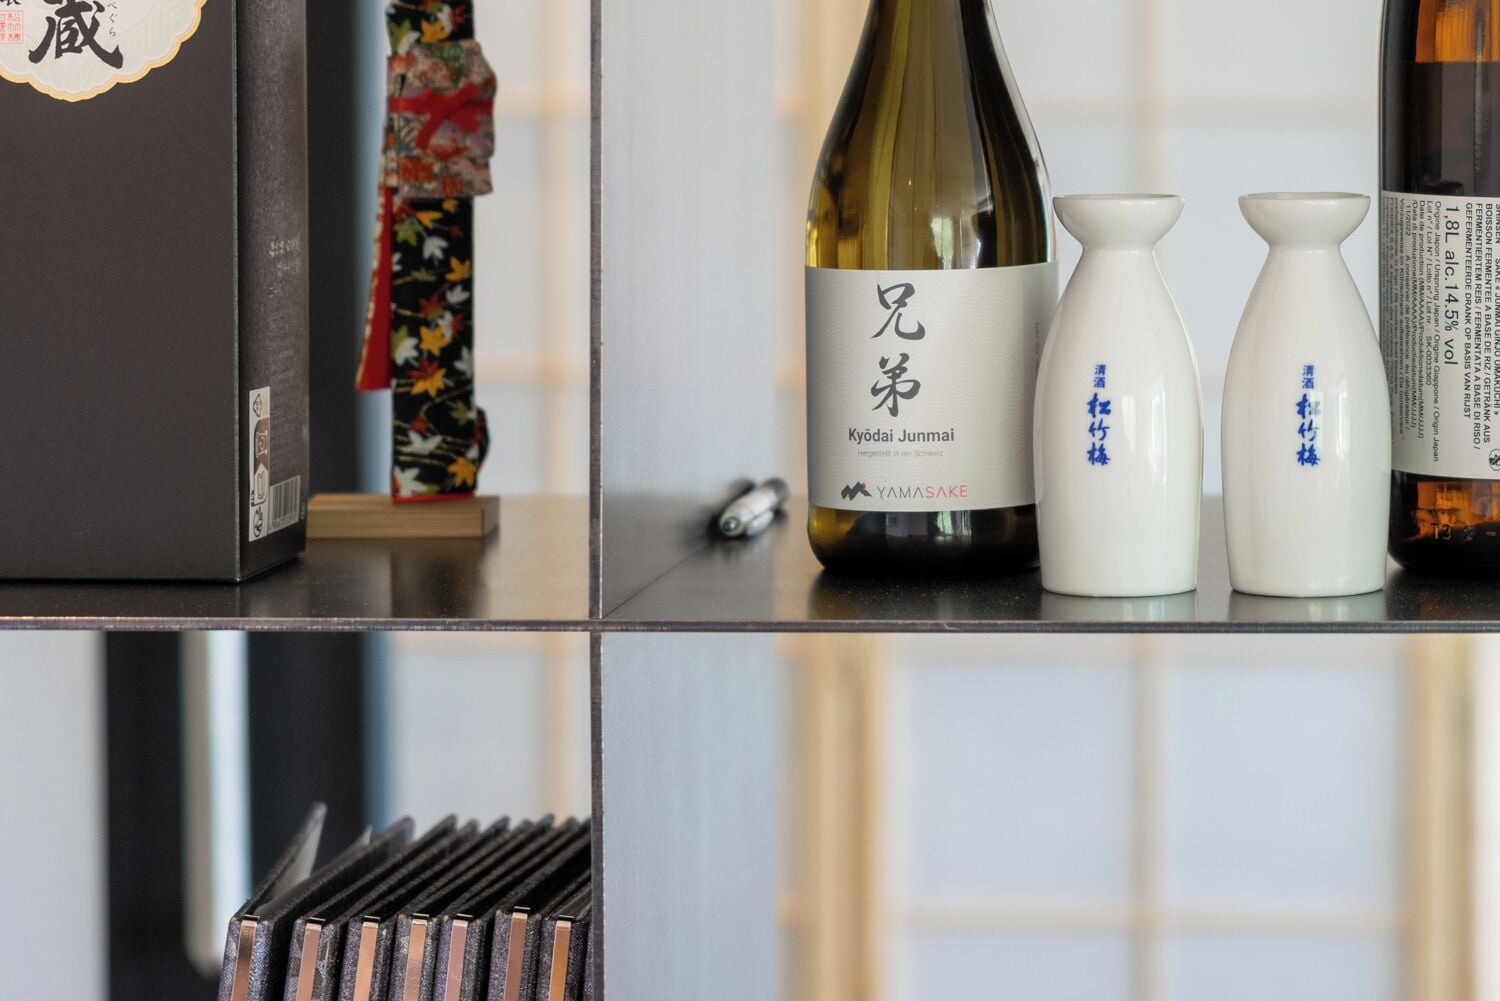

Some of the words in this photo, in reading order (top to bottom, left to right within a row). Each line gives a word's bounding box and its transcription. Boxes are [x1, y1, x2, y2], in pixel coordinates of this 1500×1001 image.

[1419, 221, 1425, 232] de
[1433, 200, 1441, 230] Origine
[1444, 205, 1460, 243] 1,8L
[1485, 203, 1493, 245] BOISSON
[1433, 232, 1441, 256] Japon
[1465, 202, 1473, 291] GEFERMENTEERDE
[1474, 203, 1483, 281] FERMENTIERTEM
[1433, 264, 1441, 301] Ursprung
[1484, 247, 1492, 303] FERMENTEE
[1474, 282, 1482, 305] REIS
[1433, 302, 1441, 328] Japan
[1464, 292, 1472, 325] DRANK
[1484, 304, 1492, 312] A
[1464, 327, 1472, 340] OP
[1484, 314, 1492, 339] BASE
[870, 282, 926, 418] 兄弟
[1433, 334, 1441, 364] Origine
[1444, 338, 1459, 365] vol
[1474, 311, 1482, 373] FERMENTATA
[1484, 340, 1492, 354] DE
[1464, 341, 1472, 370] BASIS
[1484, 355, 1492, 371] RIZ
[1433, 365, 1441, 405] Giappone
[1464, 371, 1472, 391] VAN
[1474, 374, 1481, 382] A
[1493, 359, 1500, 409] UMAKUCHI
[1464, 392, 1472, 419] RIJST
[1473, 383, 1481, 409] BASE
[1483, 377, 1492, 422] GETRÄNK
[1433, 411, 1441, 436] Origin
[1473, 410, 1481, 420] DI
[848, 427, 894, 445] Kyōdai
[898, 427, 955, 442] Junmai
[1087, 392, 1111, 466] 松竹梅
[1473, 421, 1481, 445] RISO
[1483, 423, 1491, 444] AUS
[1433, 437, 1441, 463] Japan
[876, 485, 969, 499] YAMASAKE
